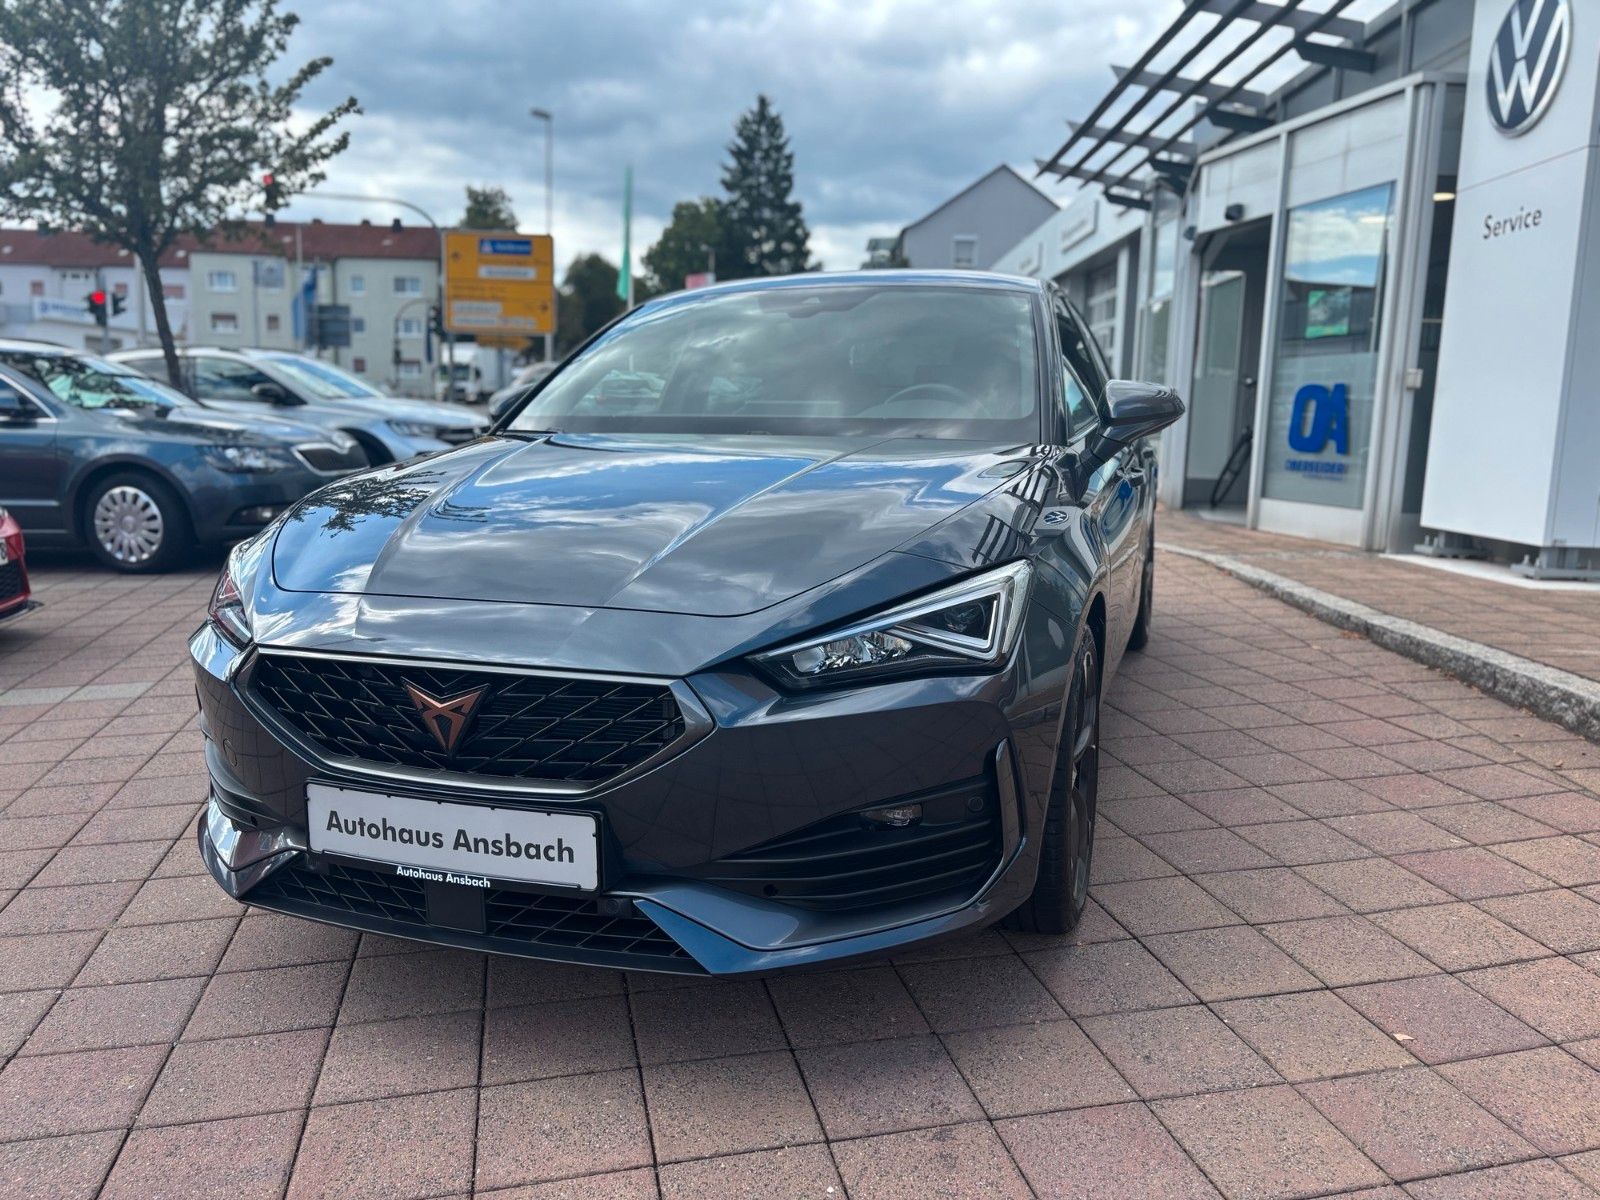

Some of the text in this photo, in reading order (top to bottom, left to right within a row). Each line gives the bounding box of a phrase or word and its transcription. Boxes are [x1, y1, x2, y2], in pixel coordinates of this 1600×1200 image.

[1483, 206, 1542, 240] Service
[326, 810, 574, 863] Autohaus Ansbach
[396, 866, 490, 888] Autohaus Ansbach
